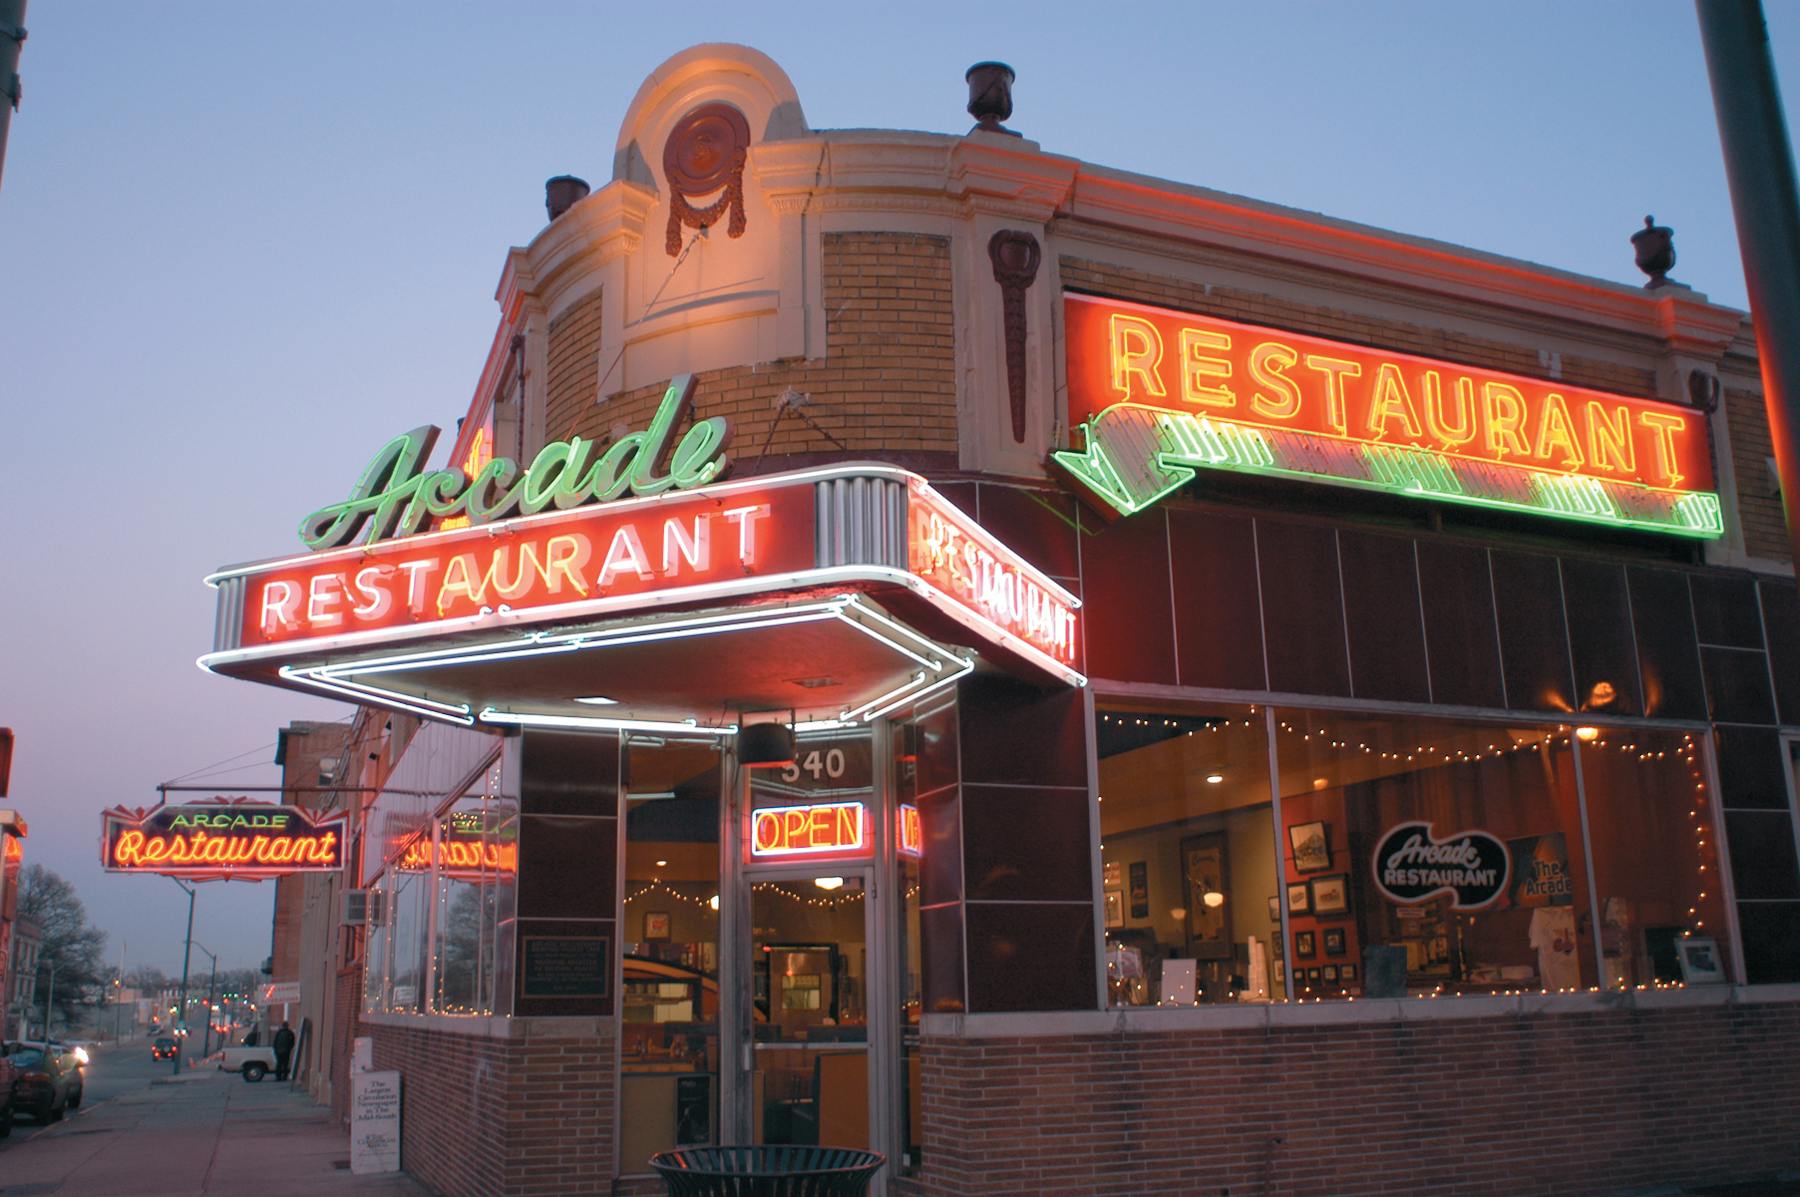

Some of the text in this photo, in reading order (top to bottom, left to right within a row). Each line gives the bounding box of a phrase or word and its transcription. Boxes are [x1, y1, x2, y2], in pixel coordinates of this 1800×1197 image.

[1111, 313, 1685, 486] RESTAURANT
[298, 373, 735, 550] Arcade
[260, 503, 771, 637] RESTAURANT
[918, 505, 1077, 661] RESTAURANT
[781, 749, 846, 783] 540
[168, 814, 289, 831] ARCADE
[756, 806, 861, 851] OPEN
[115, 829, 338, 865] Restaurant
[1387, 834, 1481, 869] Arcade
[1384, 868, 1496, 887] RESTAURANT
[1526, 877, 1572, 895] Arcade
[1534, 861, 1561, 877] The
